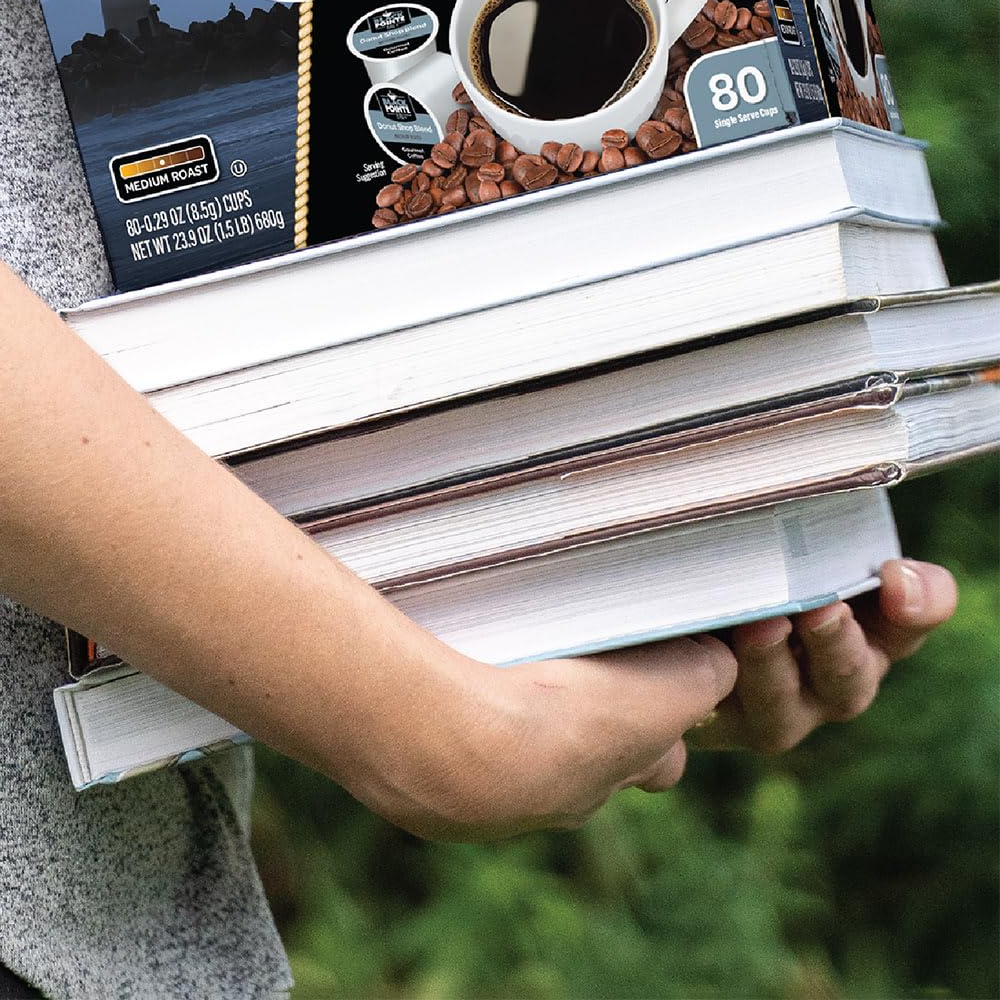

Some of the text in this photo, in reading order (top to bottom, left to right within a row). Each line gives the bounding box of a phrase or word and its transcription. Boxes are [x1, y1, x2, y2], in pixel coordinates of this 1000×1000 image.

[708, 66, 767, 112] 80
[714, 105, 779, 129] Single Serve Cups
[124, 163, 209, 194] MEDIUM ROAST
[126, 189, 252, 237] 80-0.29 OZ (8.5g) CUPS
[130, 209, 285, 262] NET WT 23.9 OZ (1.5 LB) 680g
